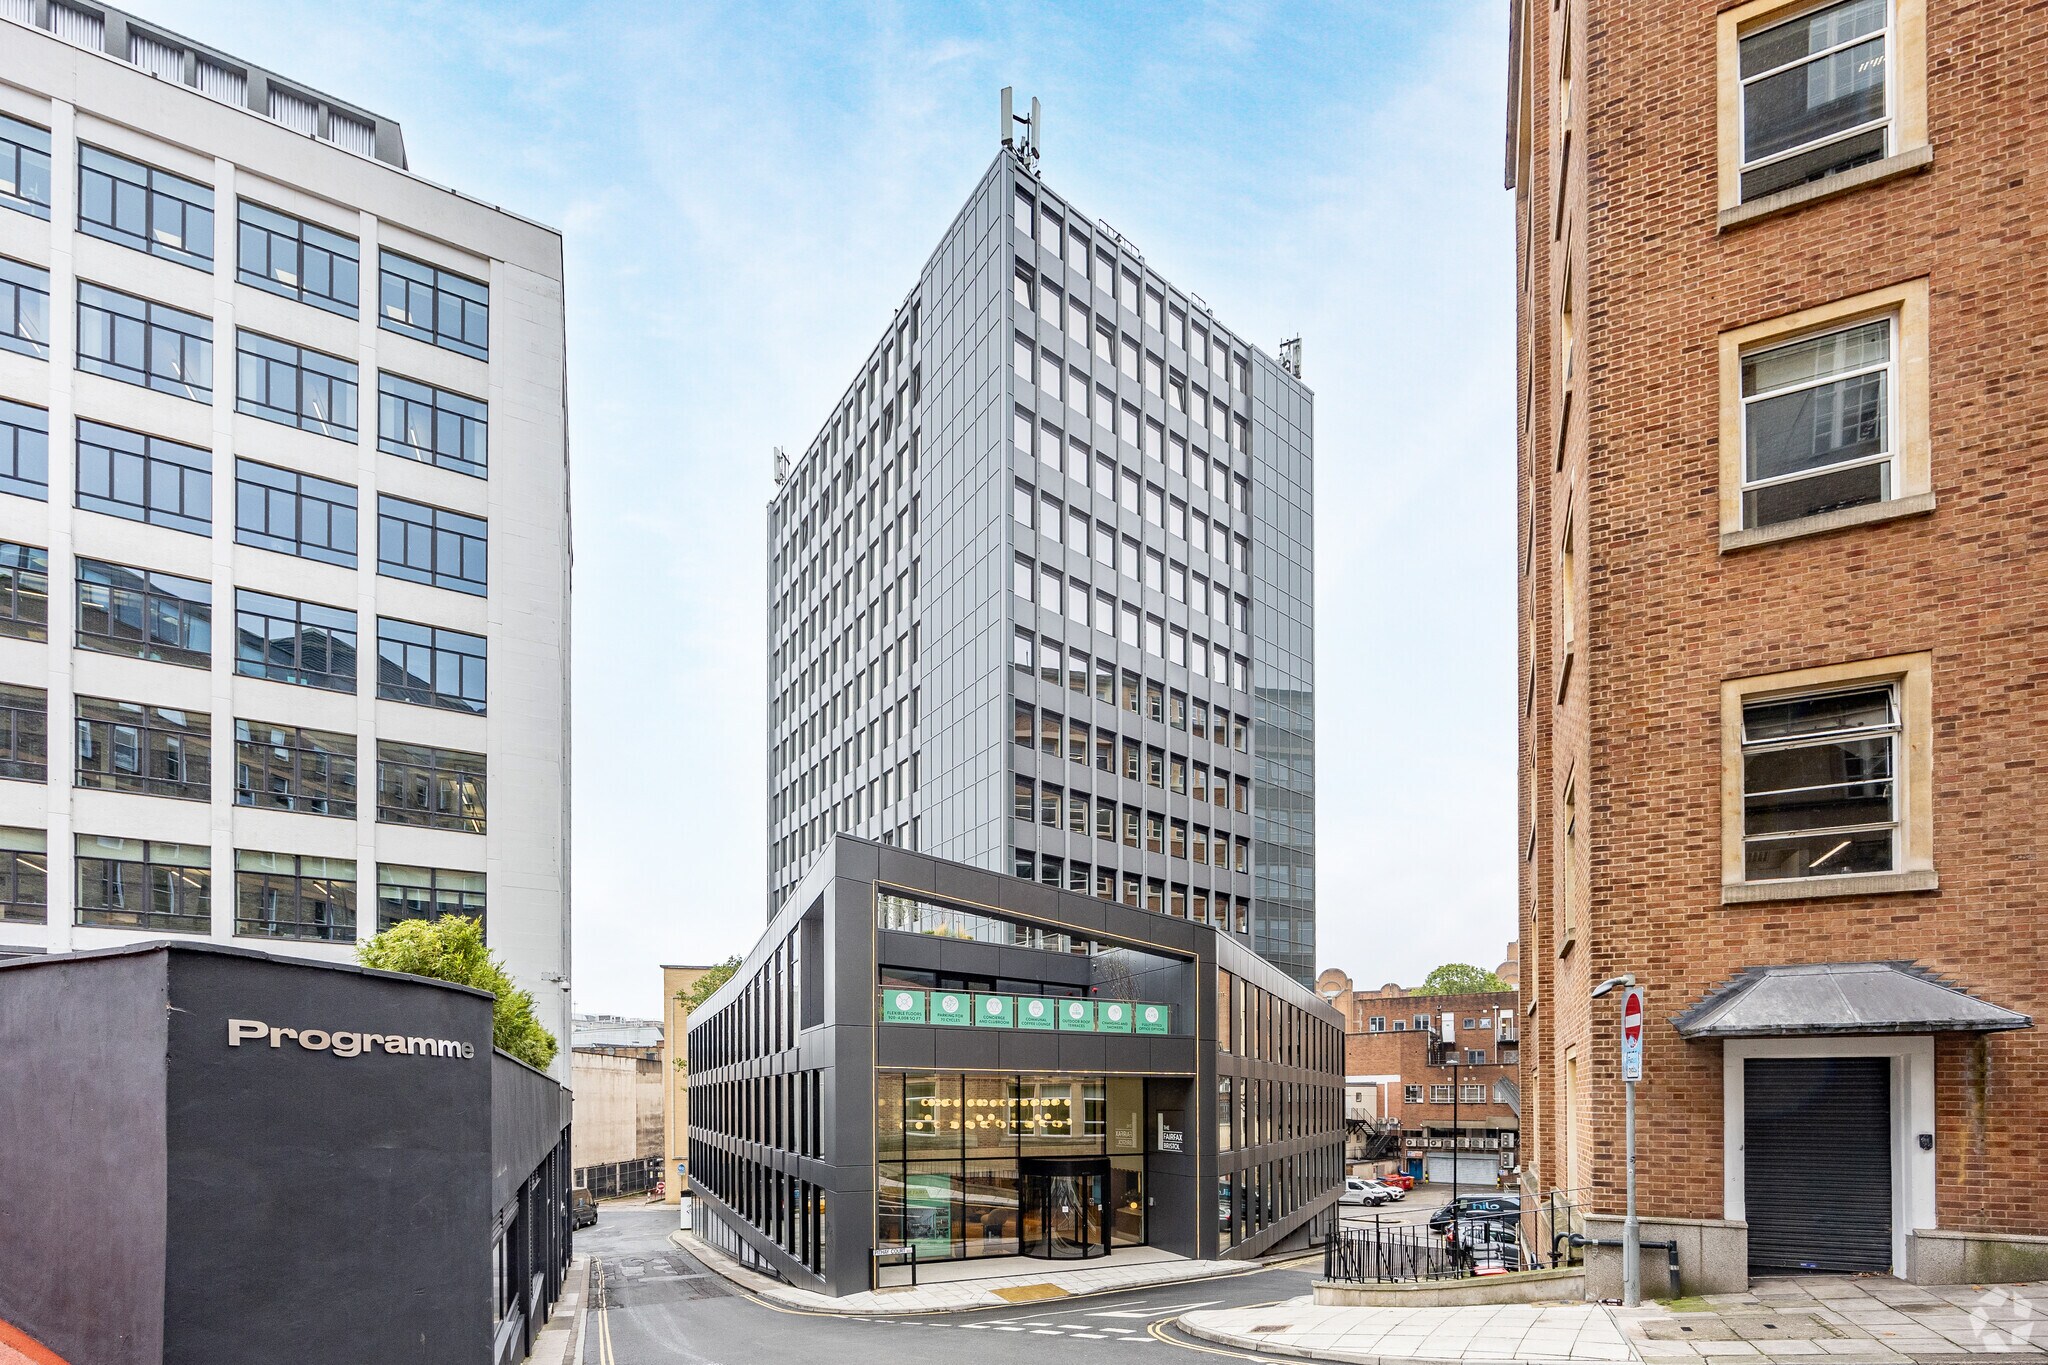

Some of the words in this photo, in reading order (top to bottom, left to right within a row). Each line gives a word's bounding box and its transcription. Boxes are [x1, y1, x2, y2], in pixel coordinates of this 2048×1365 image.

[228, 1018, 475, 1060] Programme
[1163, 1133, 1183, 1141] FAIRFAX
[1163, 1142, 1180, 1150] BRISTOL
